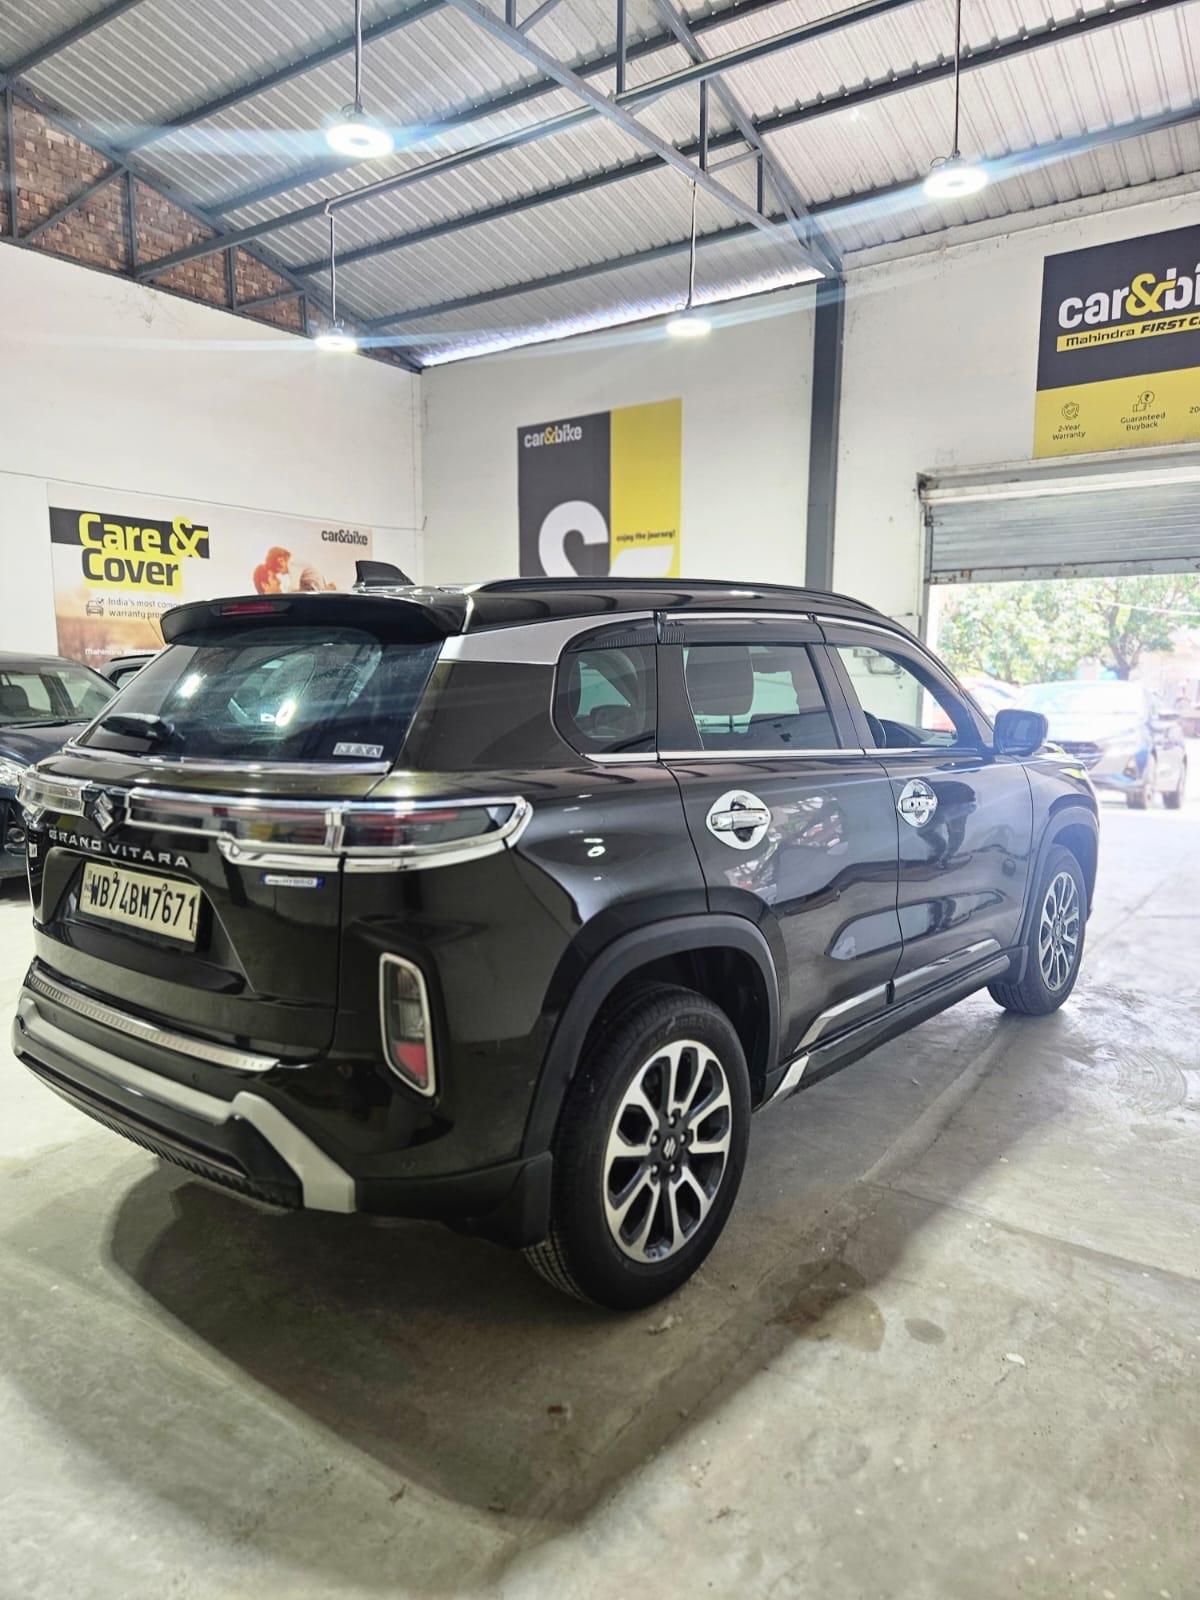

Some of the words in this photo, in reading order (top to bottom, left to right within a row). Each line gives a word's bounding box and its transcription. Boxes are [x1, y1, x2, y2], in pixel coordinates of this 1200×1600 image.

[1066, 328, 1135, 347] Mahindra
[1141, 318, 1187, 334] FIRST
[1120, 412, 1166, 424] Guaranteed
[1057, 424, 1081, 433] 2-Year
[1126, 421, 1158, 432] Buyback
[524, 424, 582, 448] car&bike
[1052, 430, 1086, 441] Warranty
[79, 512, 162, 554] Care
[169, 516, 209, 559] &
[321, 529, 368, 546] car&bike
[616, 534, 634, 543] enjoy
[635, 532, 646, 540] the
[82, 547, 179, 586] Cover
[108, 597, 135, 607] India's
[136, 599, 156, 608] most
[109, 610, 146, 619] warranty
[48, 829, 102, 852] GRAND
[108, 843, 189, 868] VITARA
[90, 873, 197, 931] WB74BM7671
